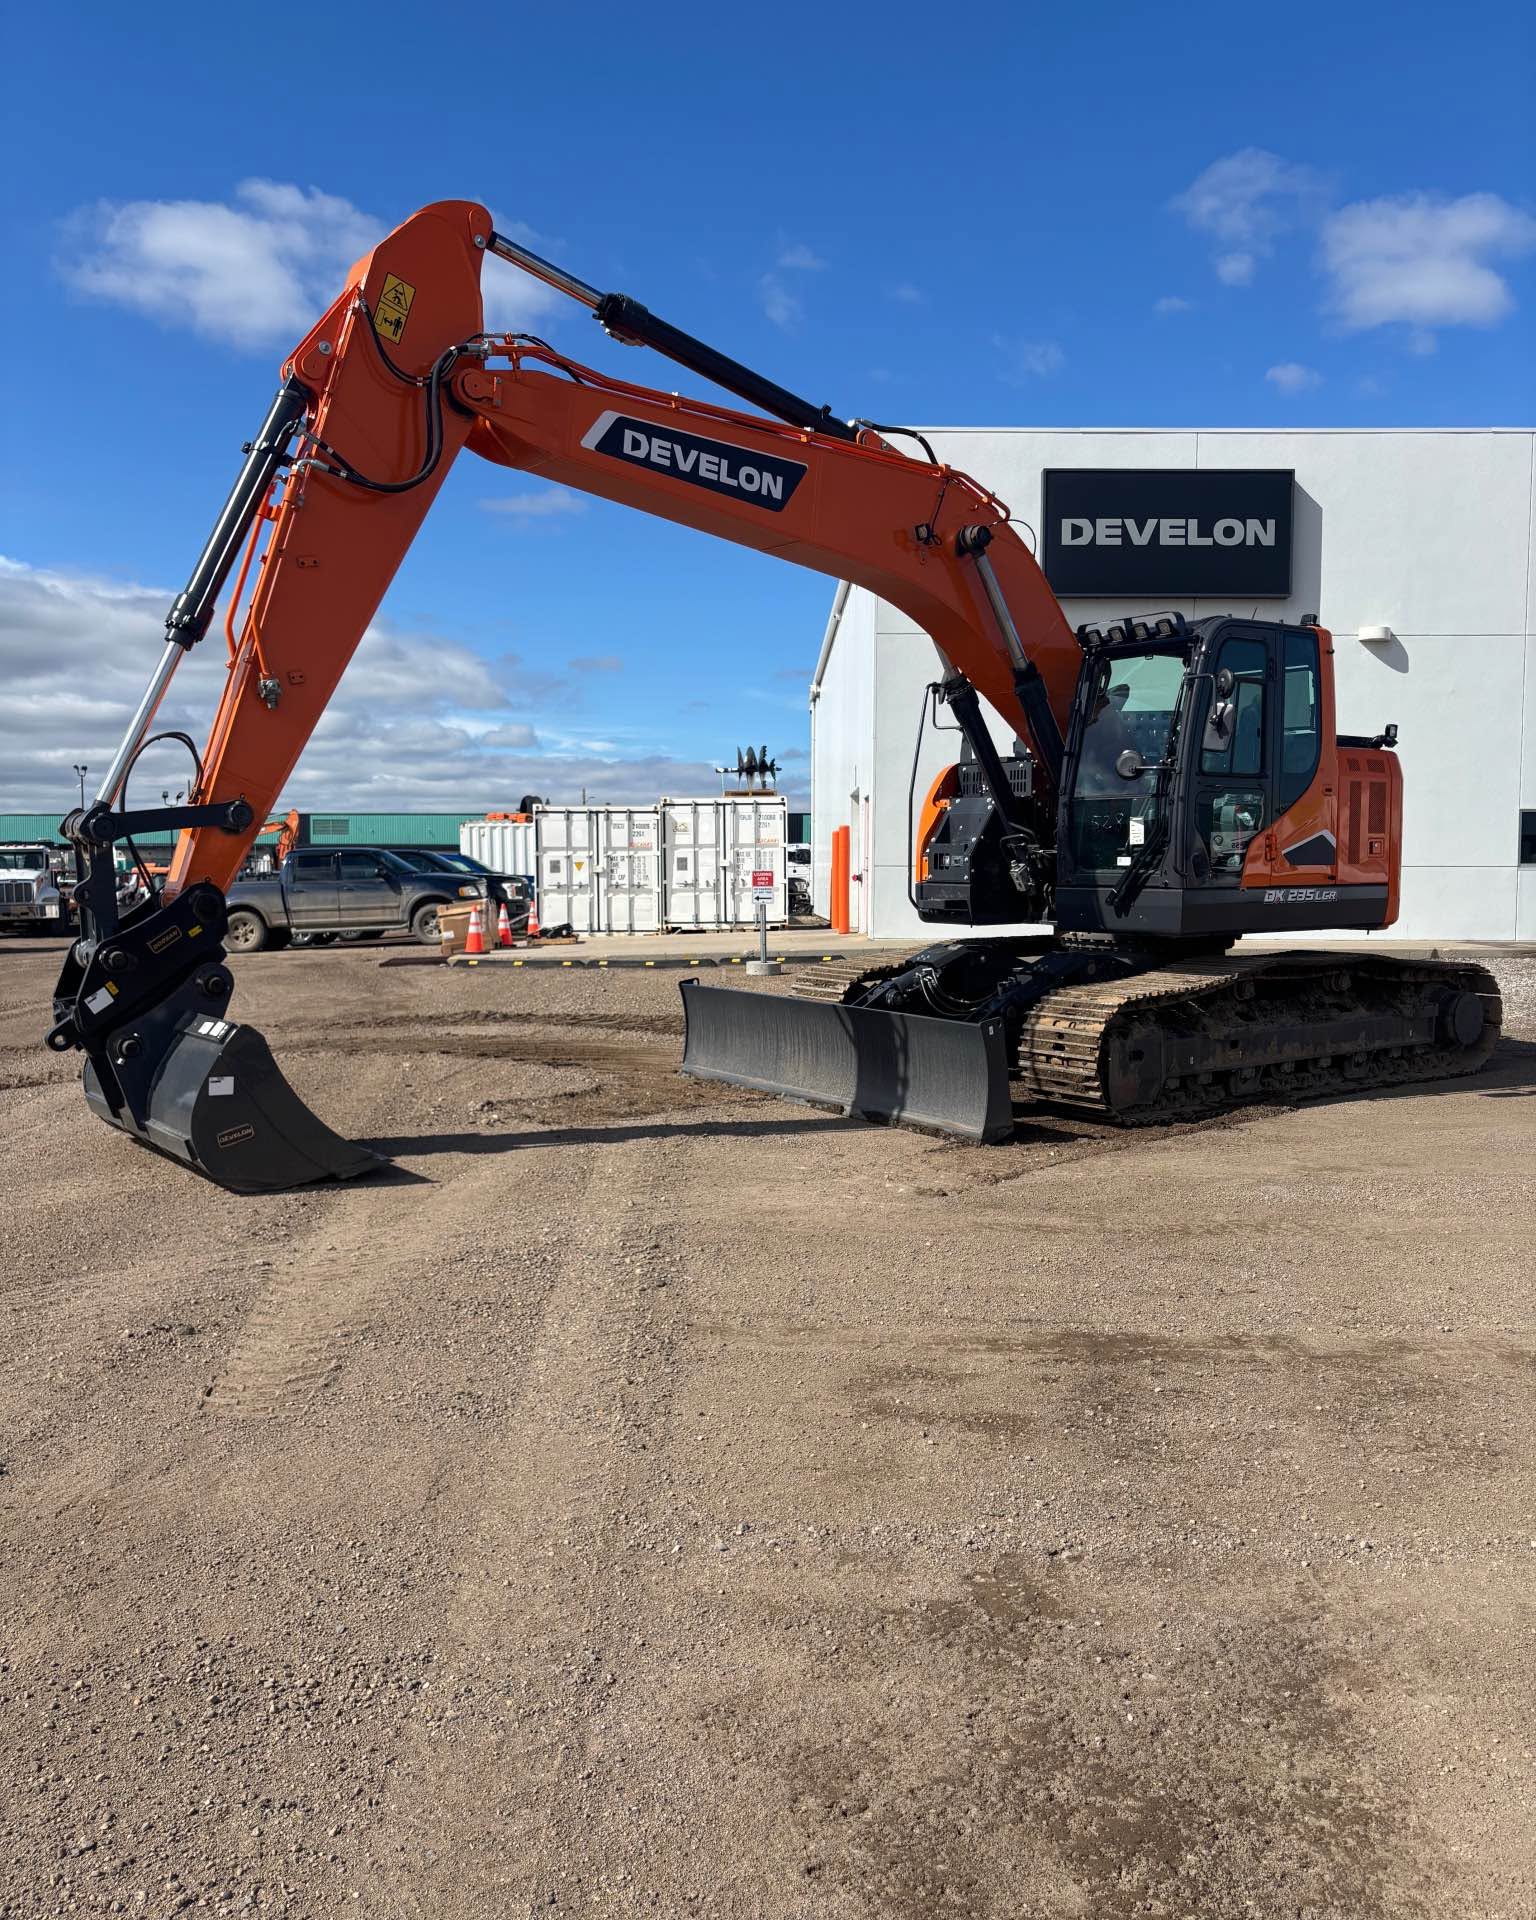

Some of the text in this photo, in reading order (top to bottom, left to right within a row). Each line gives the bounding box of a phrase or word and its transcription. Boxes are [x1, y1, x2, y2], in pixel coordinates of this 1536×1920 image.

[623, 429, 783, 500] DEVELON
[1061, 518, 1276, 546] DEVELON
[219, 1128, 252, 1143] DEVELON
